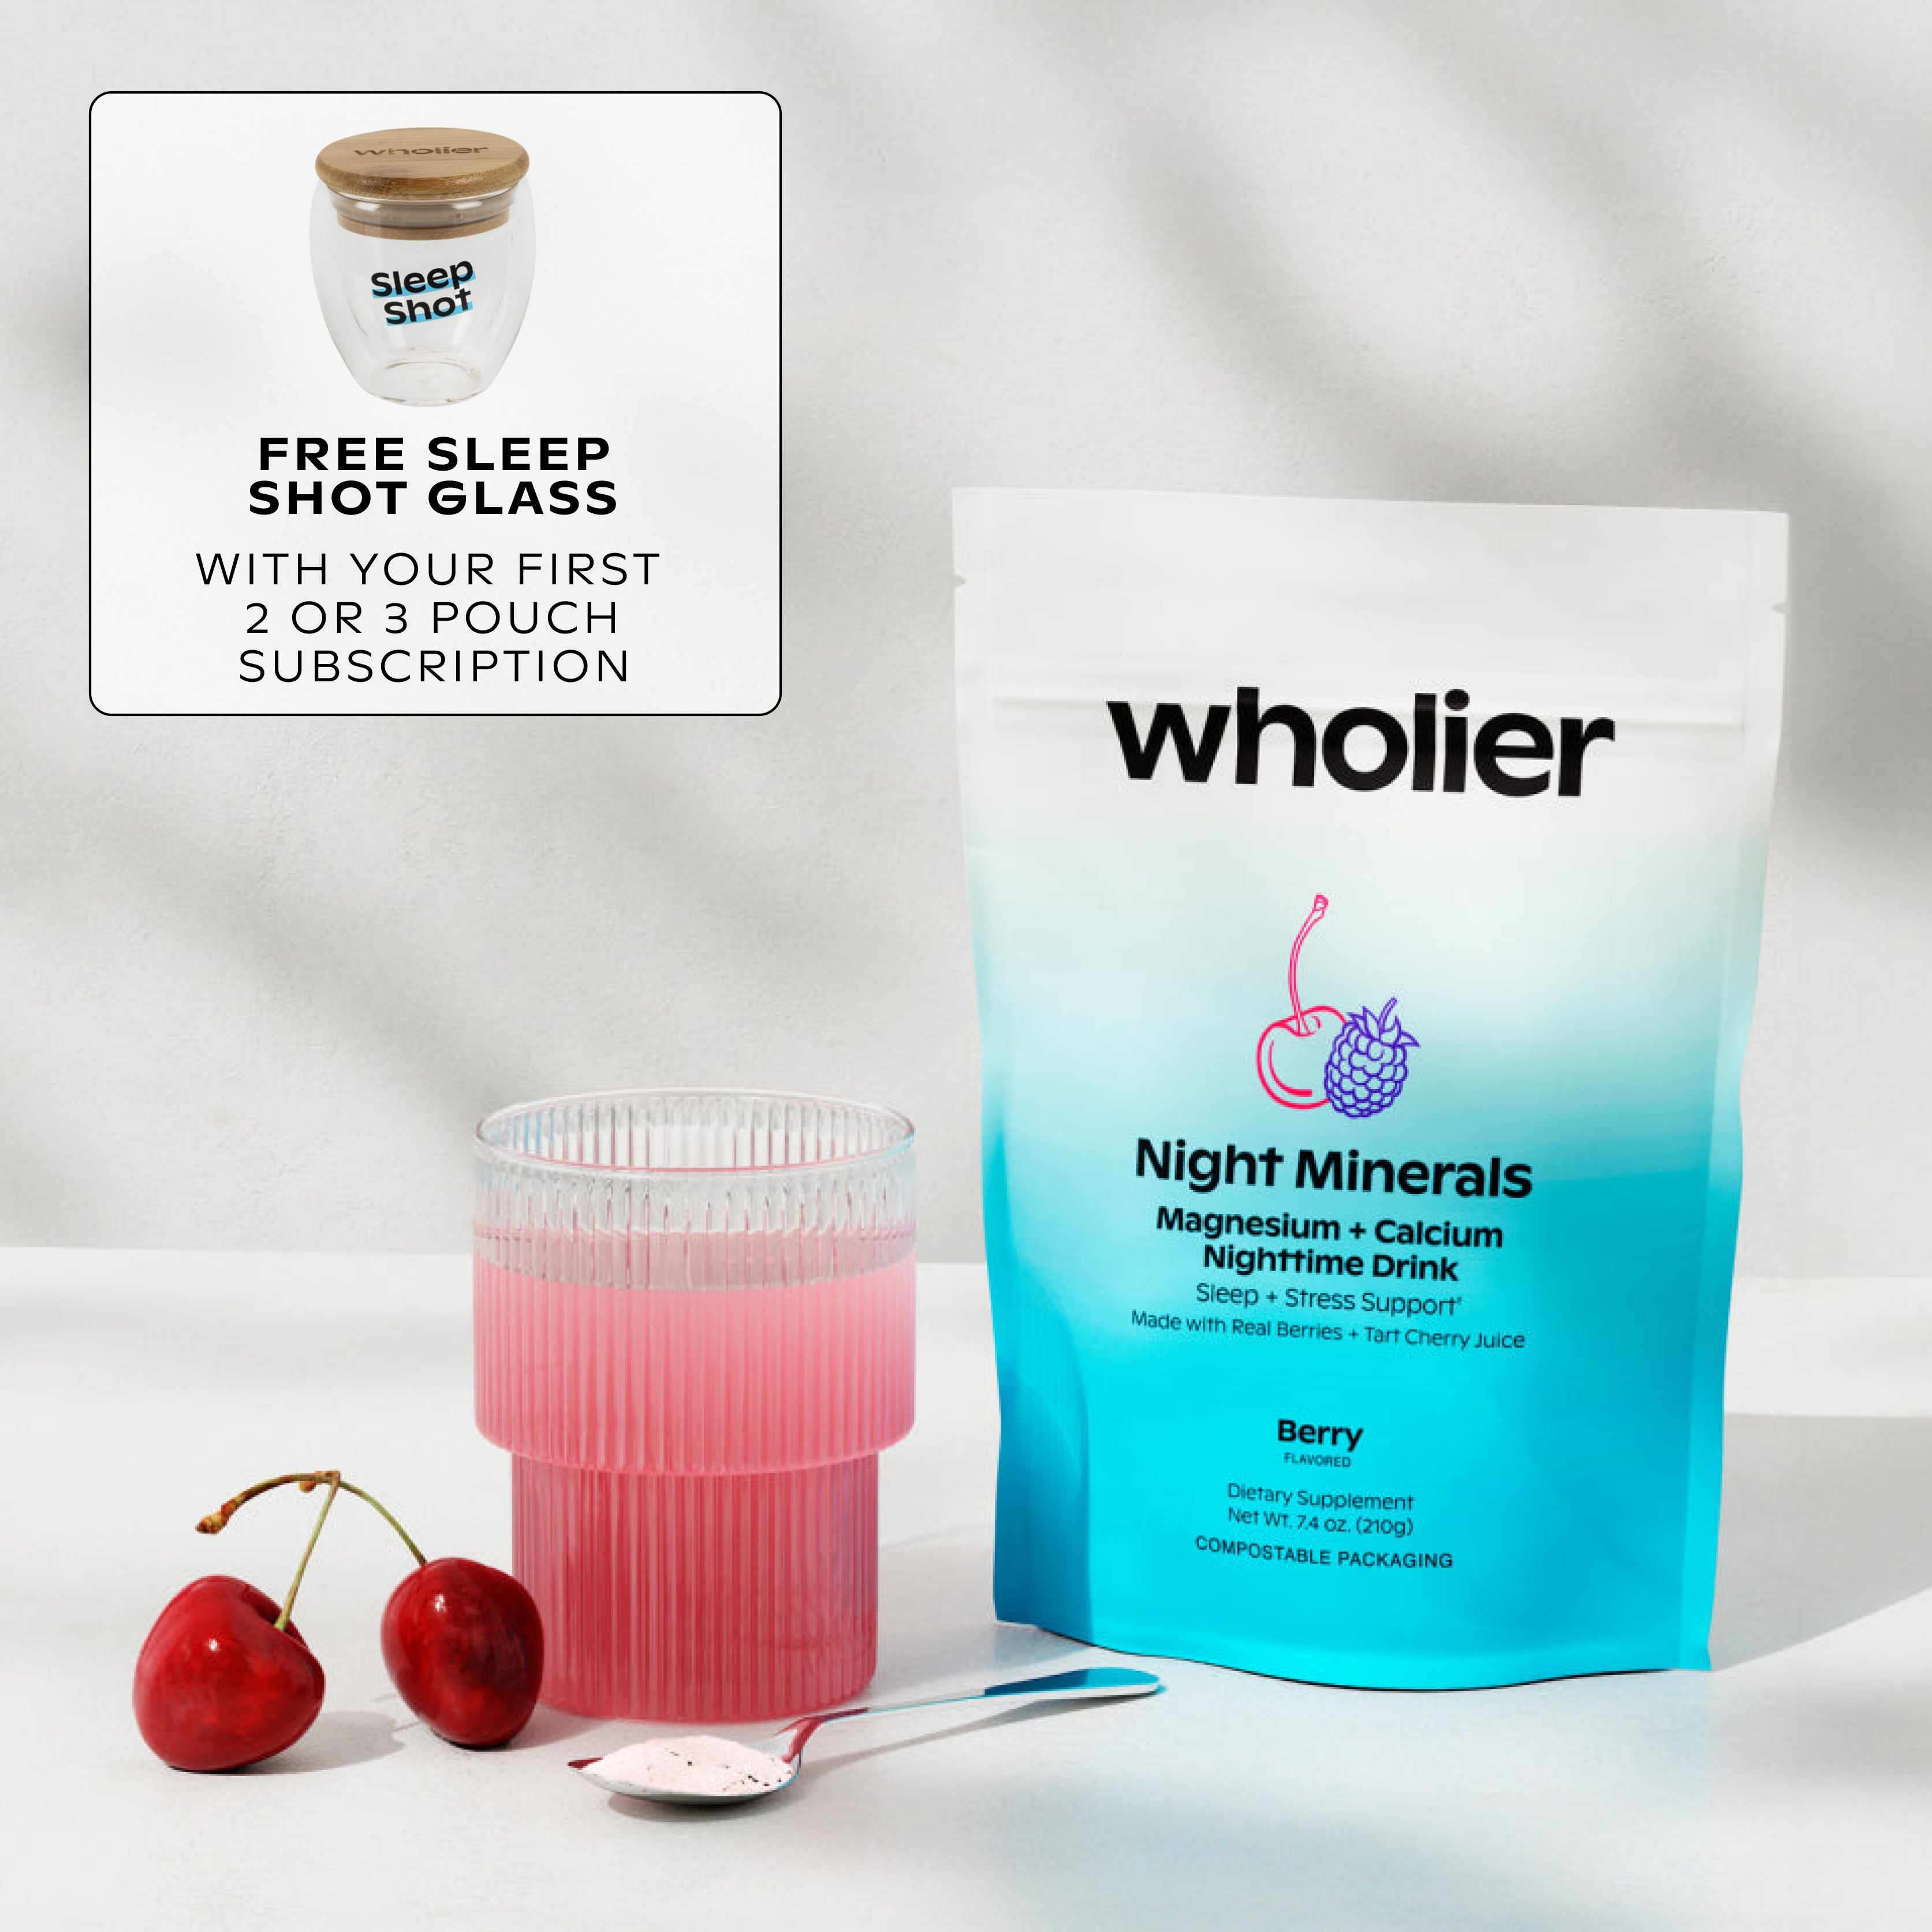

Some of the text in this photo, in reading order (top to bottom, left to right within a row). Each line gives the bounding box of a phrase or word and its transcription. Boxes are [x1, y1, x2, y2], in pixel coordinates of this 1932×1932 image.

[354, 146, 488, 156] wholier
[371, 260, 473, 297] Sleep
[383, 288, 471, 325] Shot
[1106, 687, 1616, 797] wholier
[1136, 1137, 1533, 1199] Night Minerals
[1156, 1206, 1503, 1249] Magnesium + Calcium
[1204, 1244, 1459, 1281] Nighttime Drink
[1196, 1282, 1259, 1307] Sleep
[1265, 1291, 1278, 1304] +
[1285, 1288, 1355, 1310] Stress
[1132, 1310, 1525, 1351] Made with Real Berries + Tart Cherry Juice
[1277, 1420, 1363, 1453] Berry
[1284, 1452, 1352, 1467] FLAVORED
[1228, 1482, 1414, 1510] Dietary Supplement
[1229, 1506, 1260, 1524] Net
[1263, 1512, 1292, 1528] Wt.
[1323, 1519, 1351, 1532] oz.
[1356, 1517, 1413, 1538] (210g)
[1195, 1535, 1453, 1568] COMPOSTABLE PACKAGING
